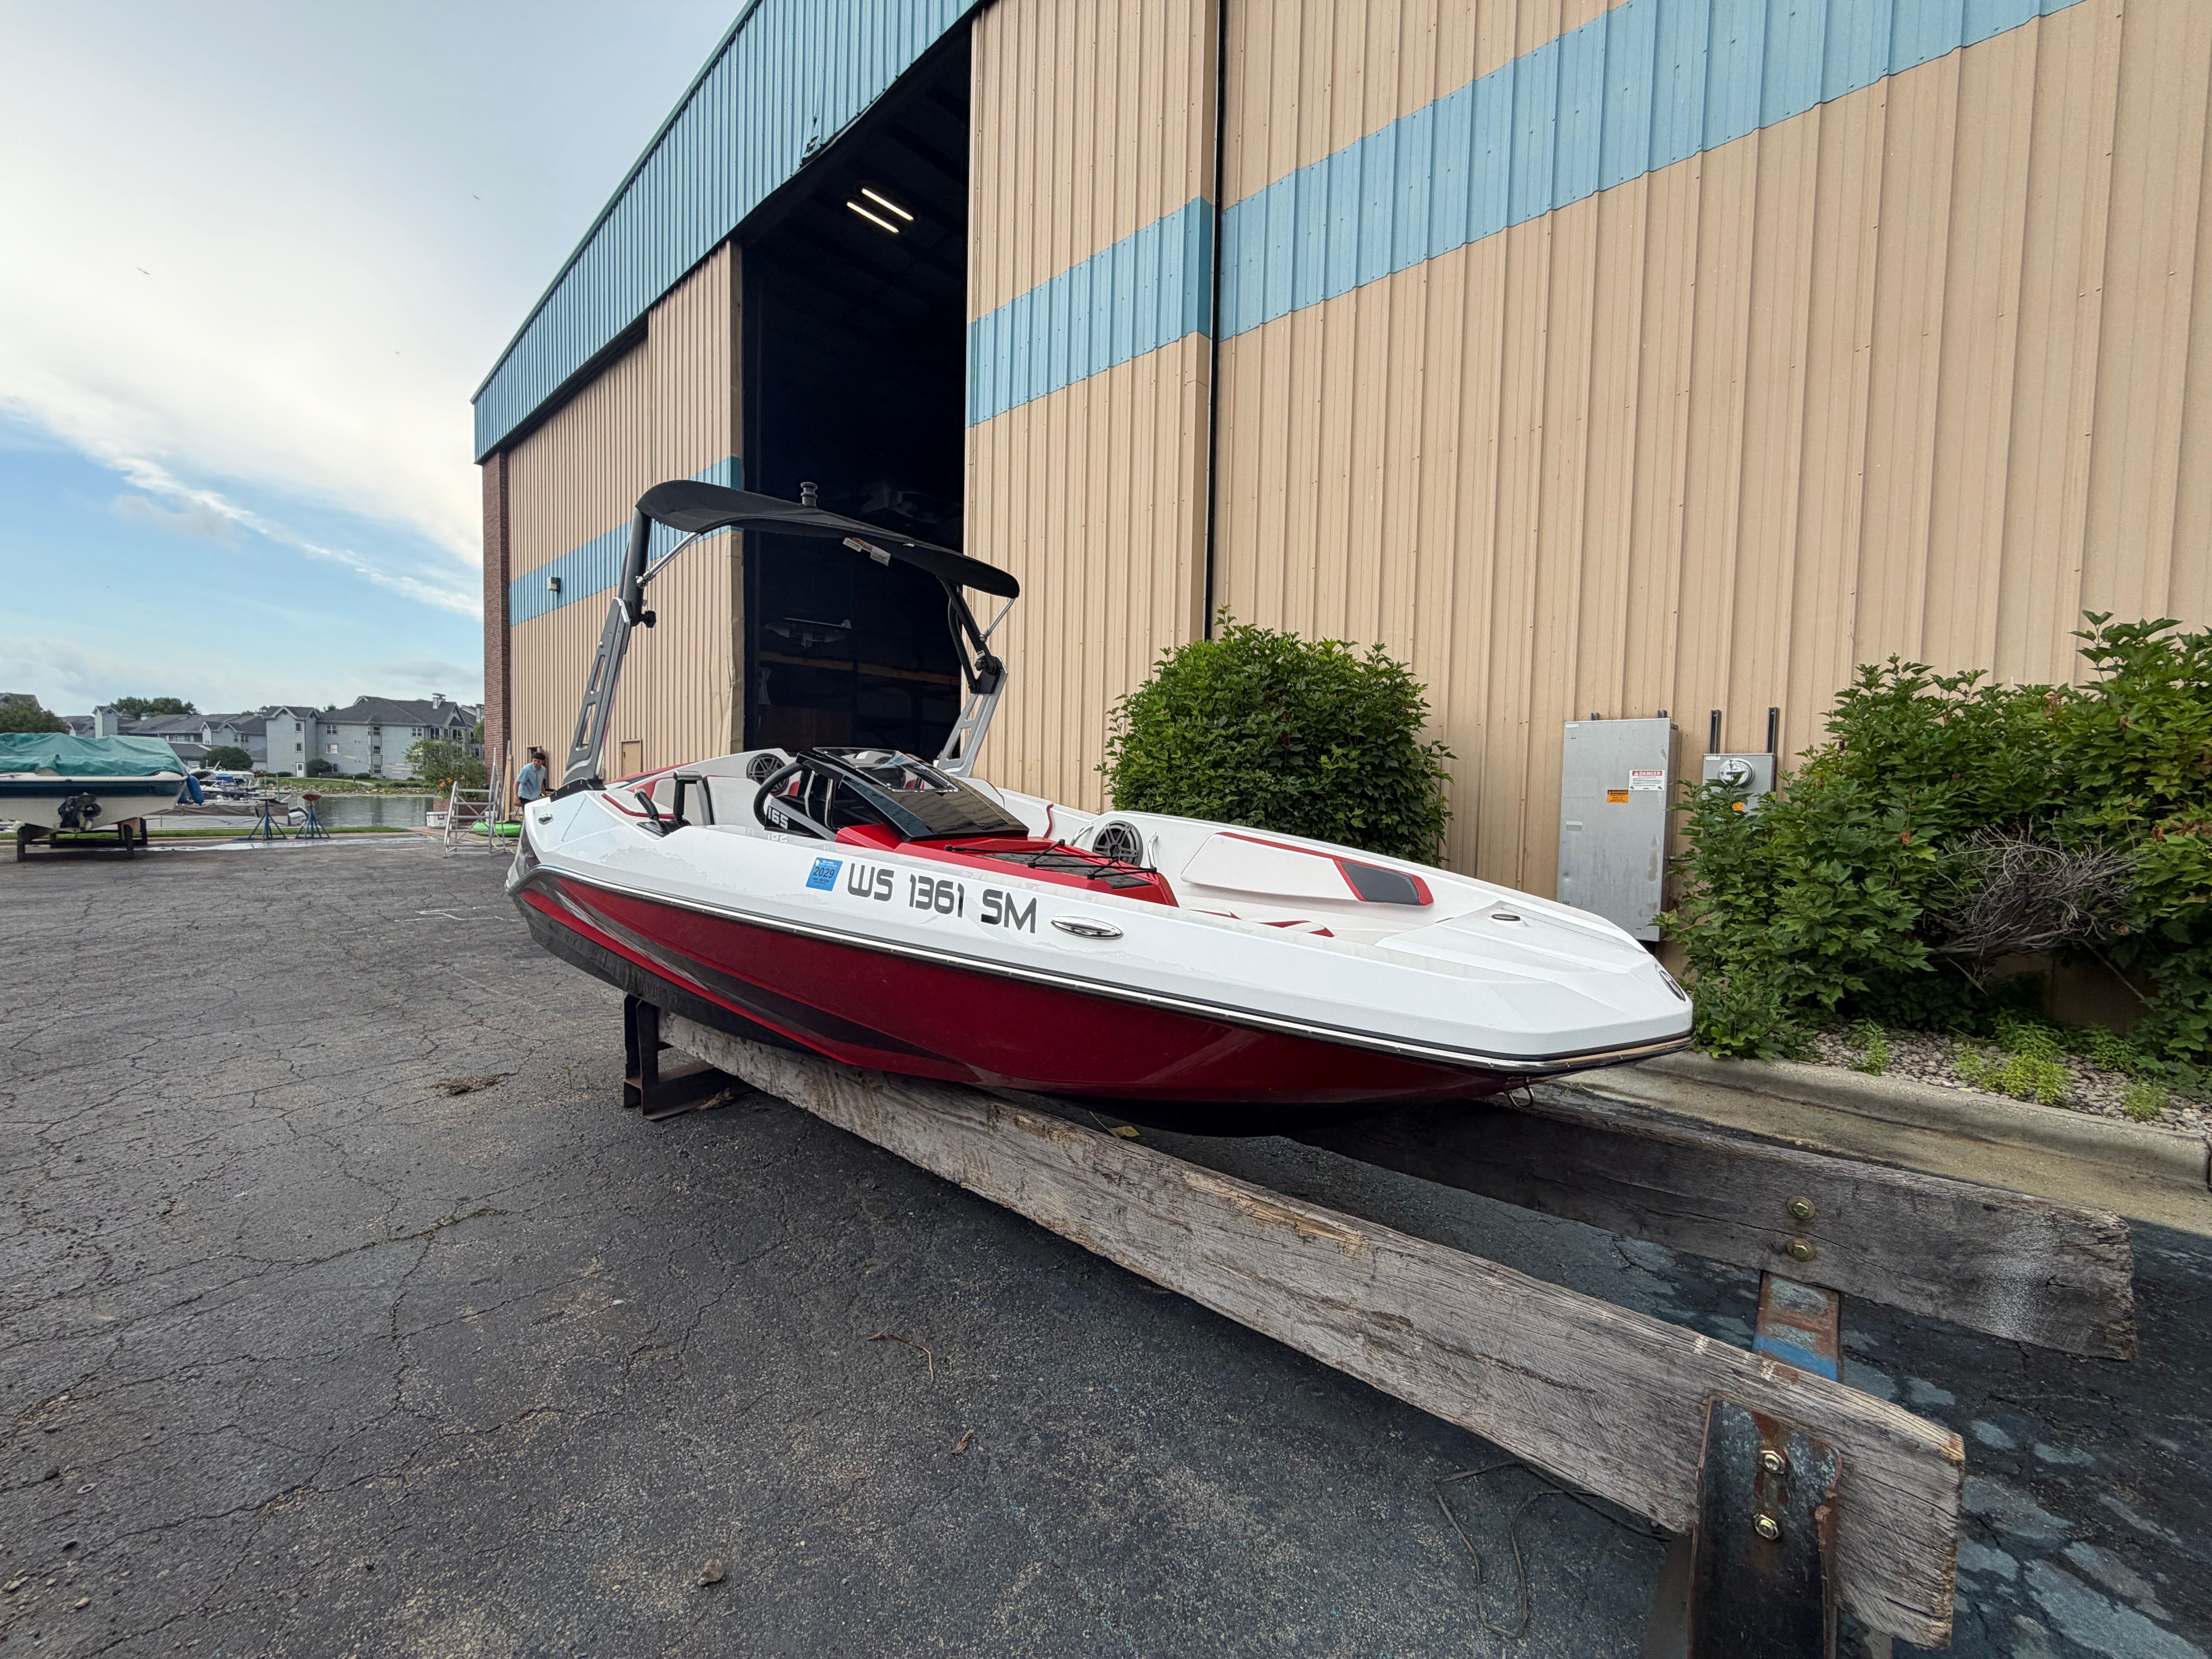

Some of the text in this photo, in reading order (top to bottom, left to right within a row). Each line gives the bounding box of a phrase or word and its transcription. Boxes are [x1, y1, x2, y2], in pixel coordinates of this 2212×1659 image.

[768, 807, 788, 830] 165
[812, 866, 835, 879] 2029
[847, 863, 1037, 934] WS 1361 SM
